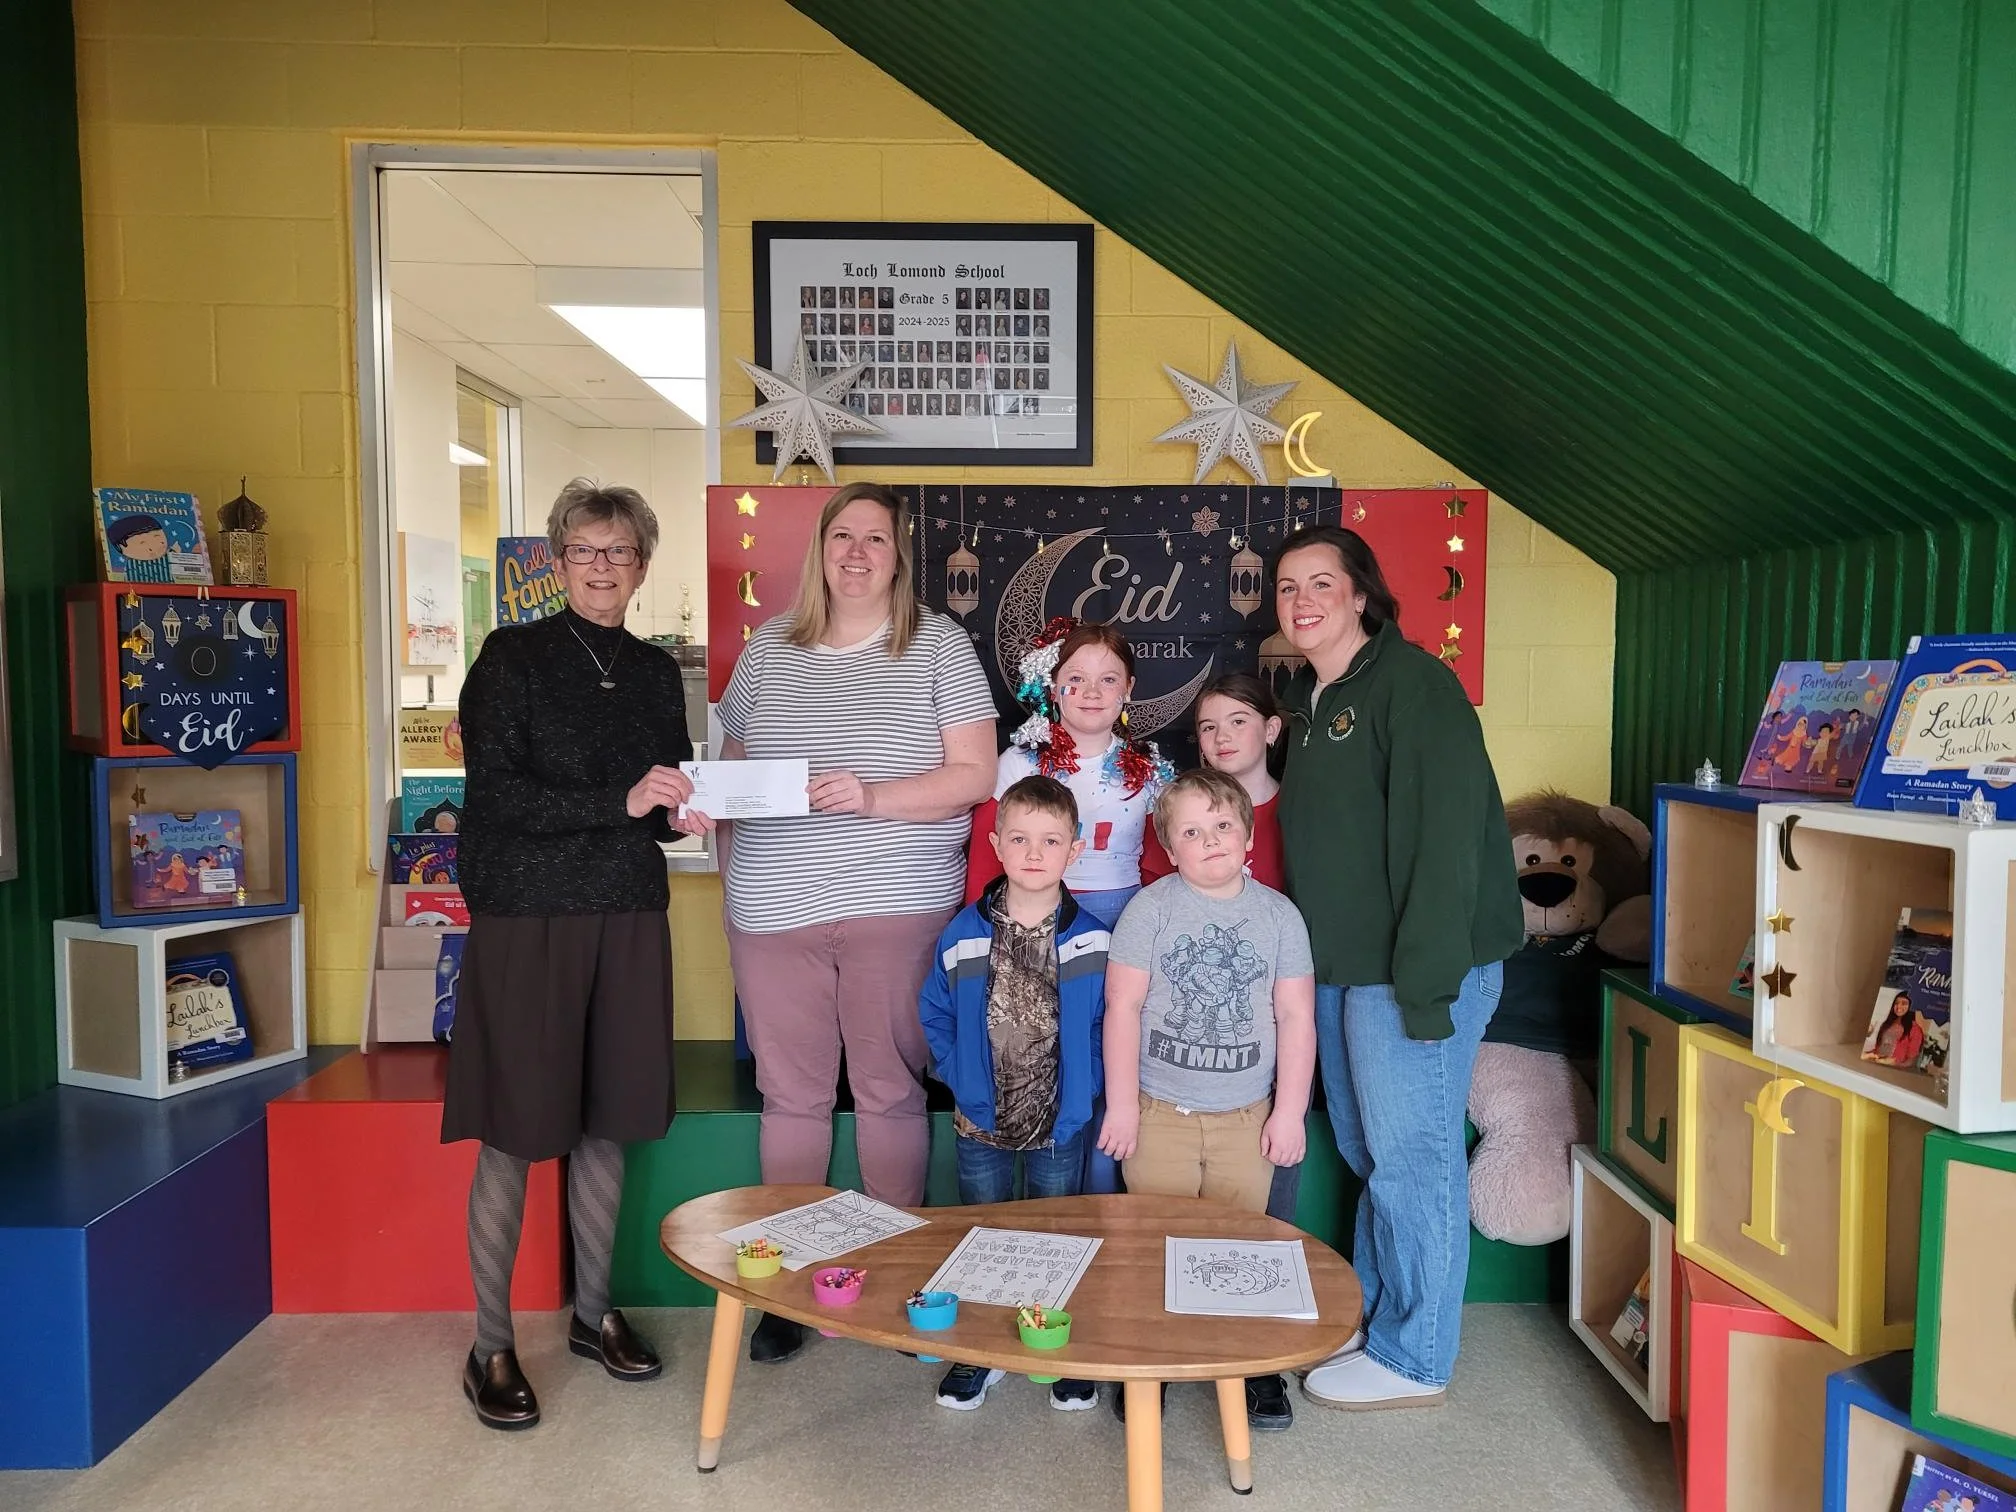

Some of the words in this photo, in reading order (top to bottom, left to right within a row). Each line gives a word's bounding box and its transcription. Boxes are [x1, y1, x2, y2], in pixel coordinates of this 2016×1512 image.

[842, 262, 878, 279] Loch
[887, 262, 946, 278] Lomond
[955, 264, 1005, 280] School
[899, 292, 935, 305] Grade
[942, 293, 950, 305] 5
[898, 317, 950, 326] 2024-2025
[113, 491, 142, 504] My
[144, 493, 180, 505] First
[108, 501, 189, 516] Ramadan
[1072, 554, 1184, 627] Eid
[1128, 635, 1194, 659] arak
[160, 692, 202, 706] DAYS
[211, 691, 255, 705] UNTIL
[1919, 690, 2016, 740] Lailah's
[178, 708, 244, 753] Eid
[400, 725, 443, 734] ALLERGY
[403, 735, 442, 743] AWARE!
[1935, 728, 2012, 763] Lunchbox
[406, 785, 432, 797] Night
[434, 784, 465, 794] Before
[1905, 779, 1912, 787] A
[1913, 779, 1950, 789] Ramadan
[1951, 781, 1974, 792] Story
[167, 991, 225, 1029] Lailah's
[185, 1013, 232, 1040] Lunchbox
[1157, 1038, 1254, 1069] #TMNT
[1952, 1477, 1962, 1486] M.
[1963, 1481, 1972, 1490] O.
[1973, 1486, 1999, 1503] YUKSEL
